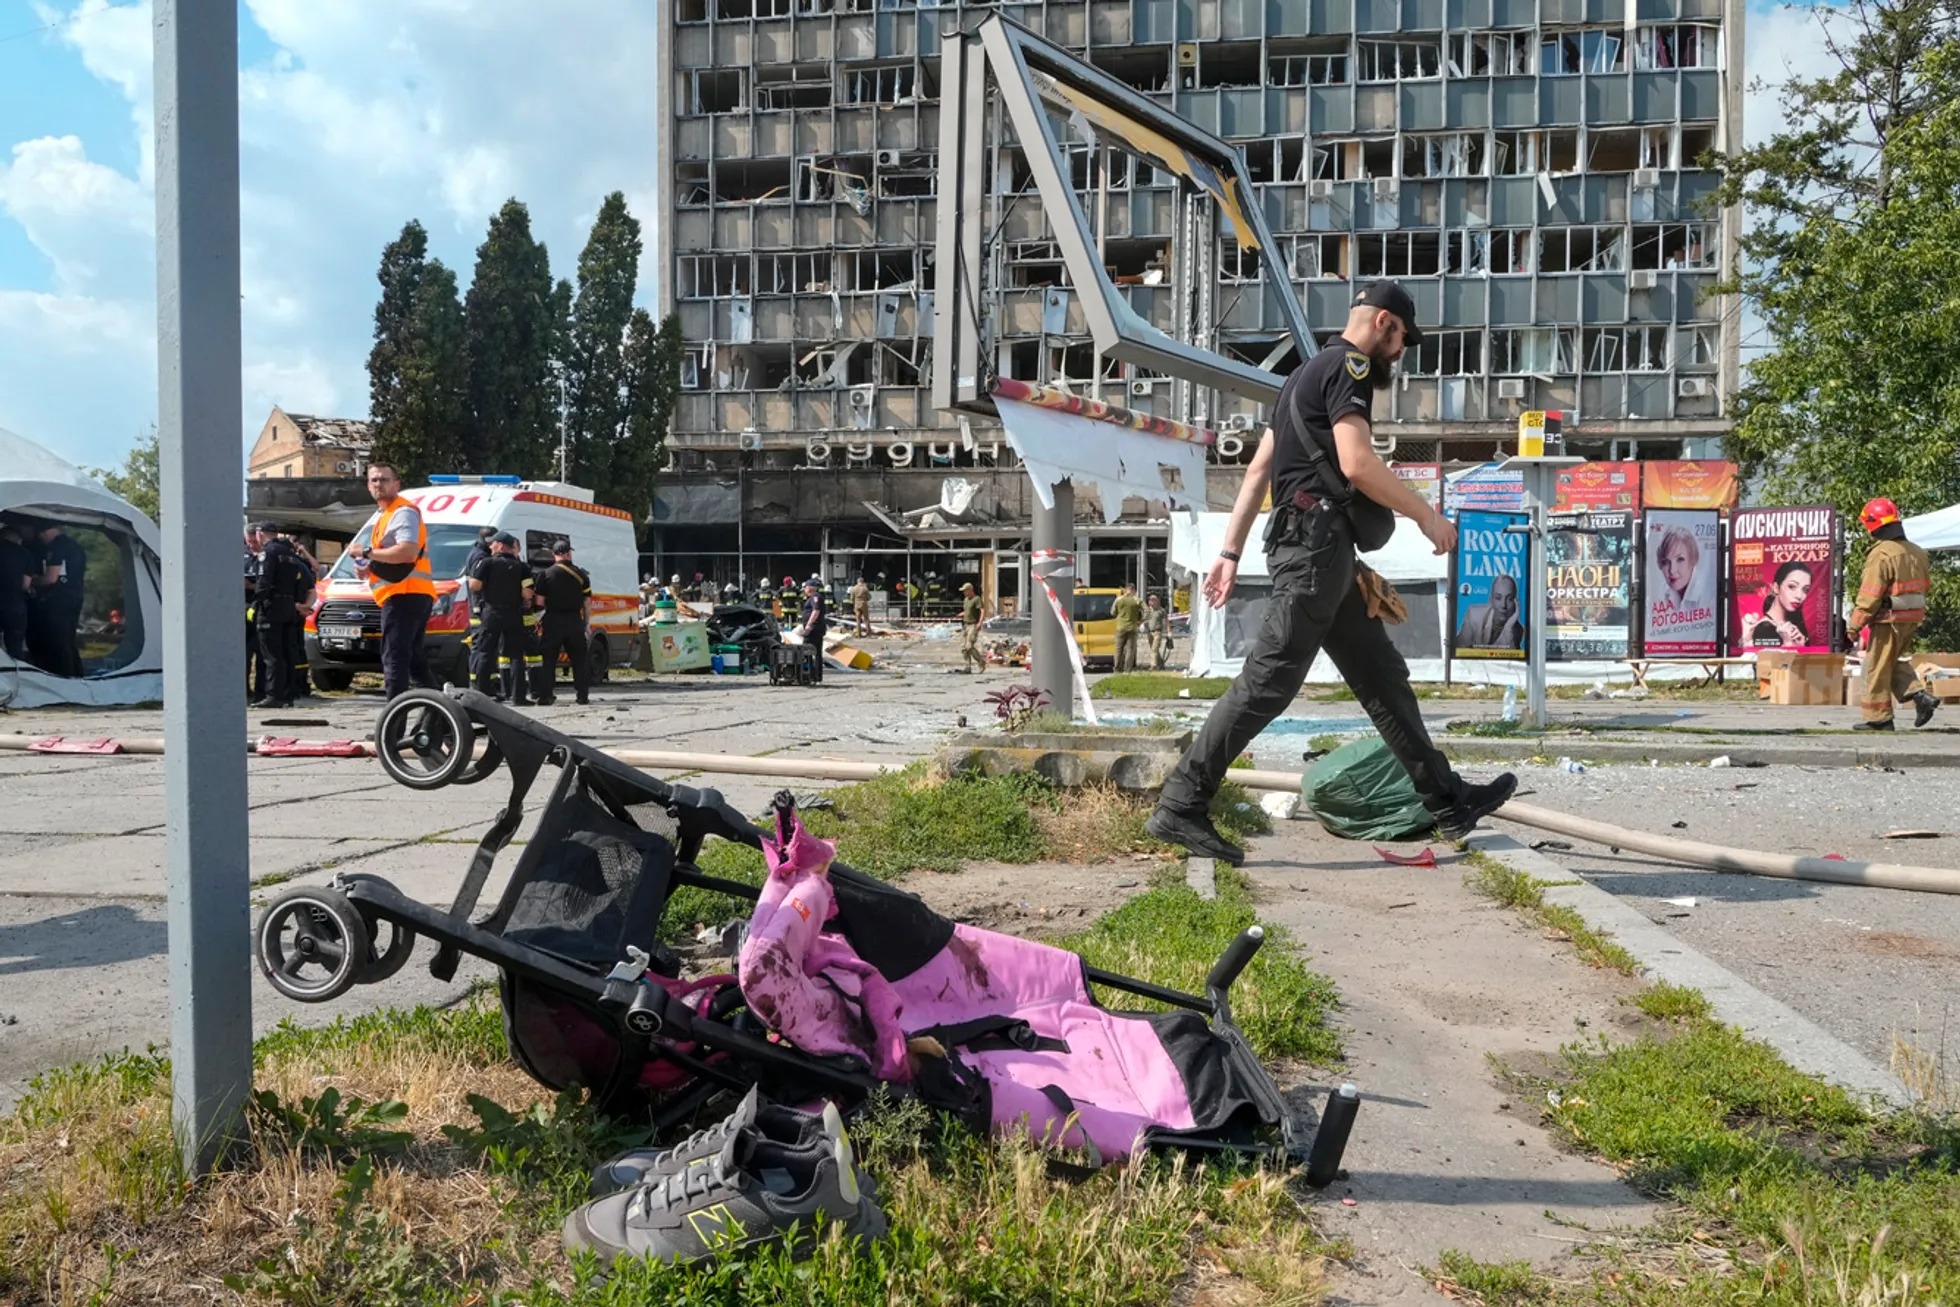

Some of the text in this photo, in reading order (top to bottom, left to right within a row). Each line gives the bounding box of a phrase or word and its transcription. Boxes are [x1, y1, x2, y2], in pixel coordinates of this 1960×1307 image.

[1772, 550, 1830, 563] КУХАР
[1464, 553, 1522, 578] LANA
[1547, 587, 1620, 599] ОРКЕСТРА
[1652, 599, 1675, 614] АДА
[1652, 607, 1713, 629] РОГОВЦЕВА
